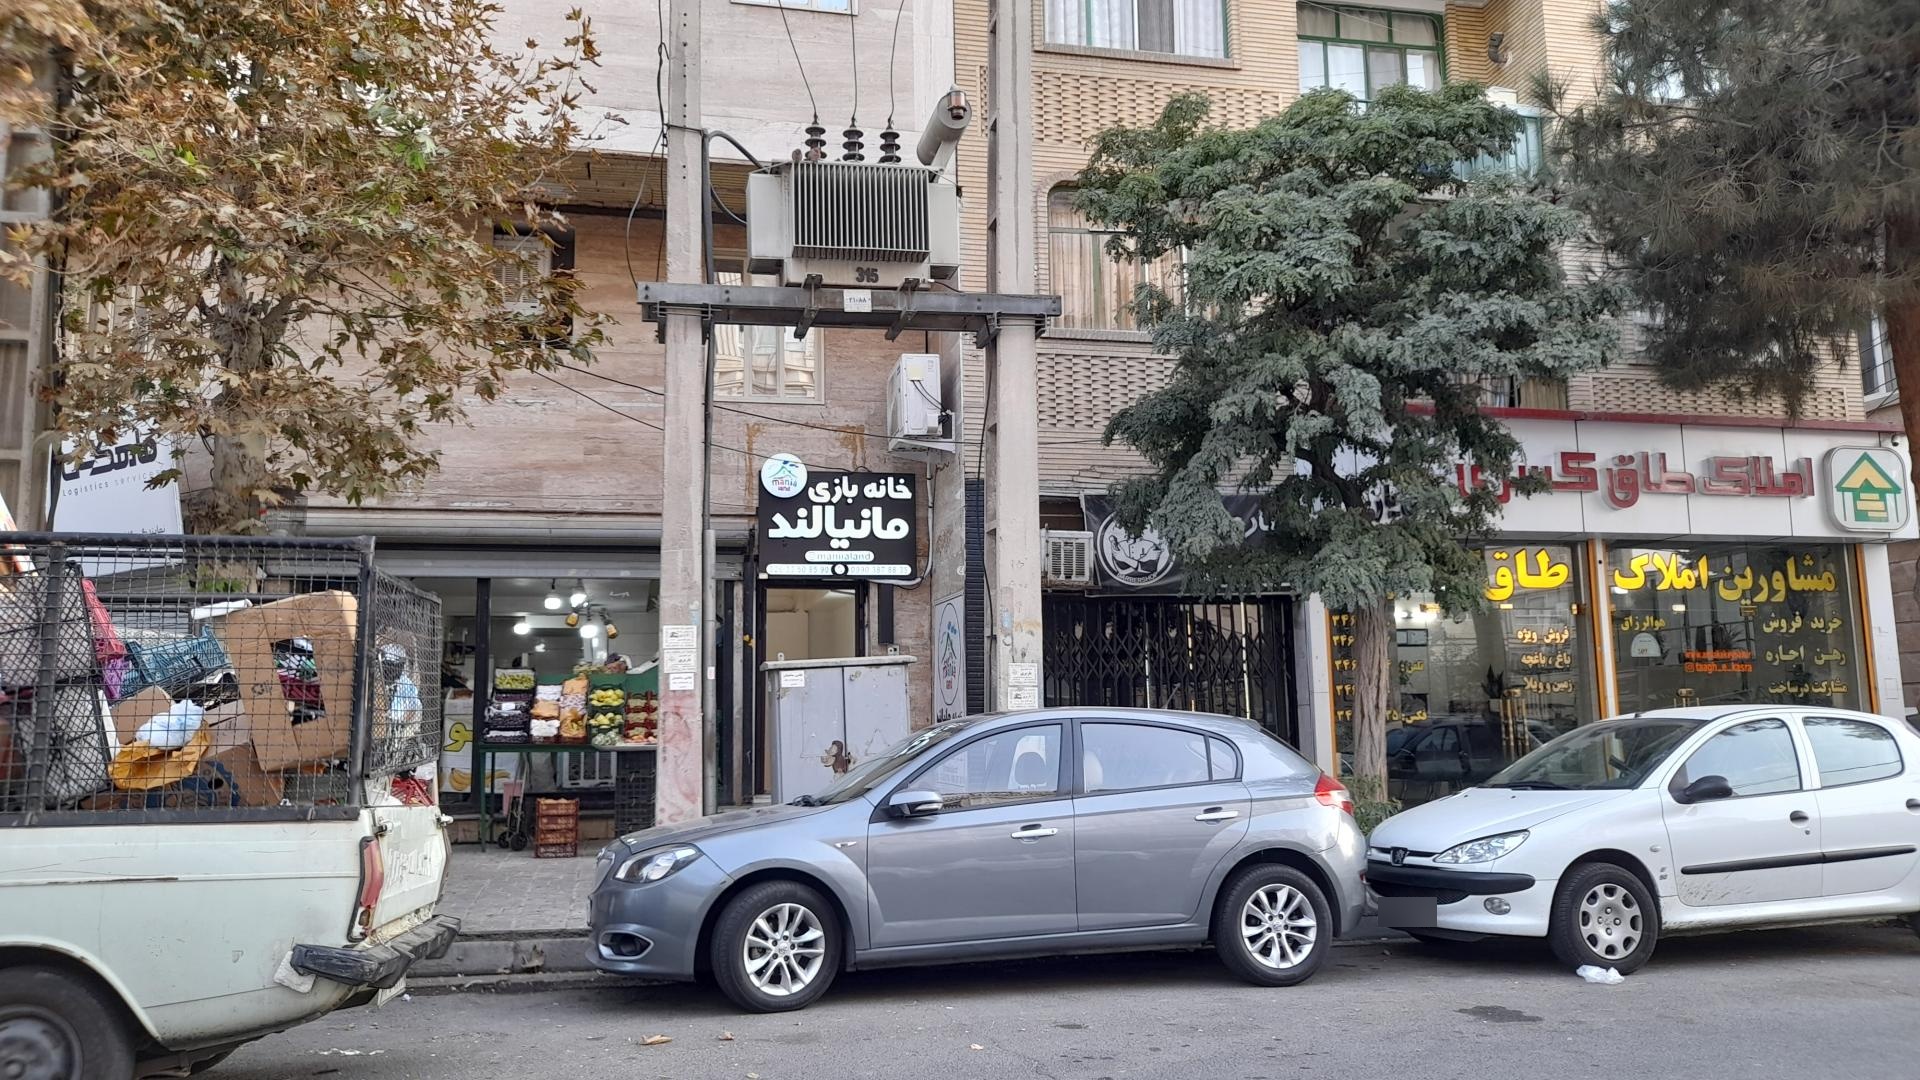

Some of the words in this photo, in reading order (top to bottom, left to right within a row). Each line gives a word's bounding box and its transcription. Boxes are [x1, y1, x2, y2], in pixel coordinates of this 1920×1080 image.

[856, 266, 879, 283] 315
[863, 476, 913, 500] خانه
[1605, 451, 1696, 509] طاق
[1701, 455, 1815, 497] املاک
[62, 480, 109, 498] Logistics
[808, 475, 859, 504] بازی
[768, 505, 910, 549] مانیالند
[1484, 548, 1570, 602] طاق
[1614, 551, 1710, 591] املاک
[1718, 553, 1837, 606] مشاورین
[1762, 611, 1803, 634] فروش
[1810, 610, 1842, 634] خرید
[1516, 627, 1538, 644] ویژه
[1543, 625, 1570, 644] فروش
[1765, 645, 1804, 668] اجاره
[1814, 648, 1847, 666] رهن
[1811, 677, 1849, 697] مشارکت
